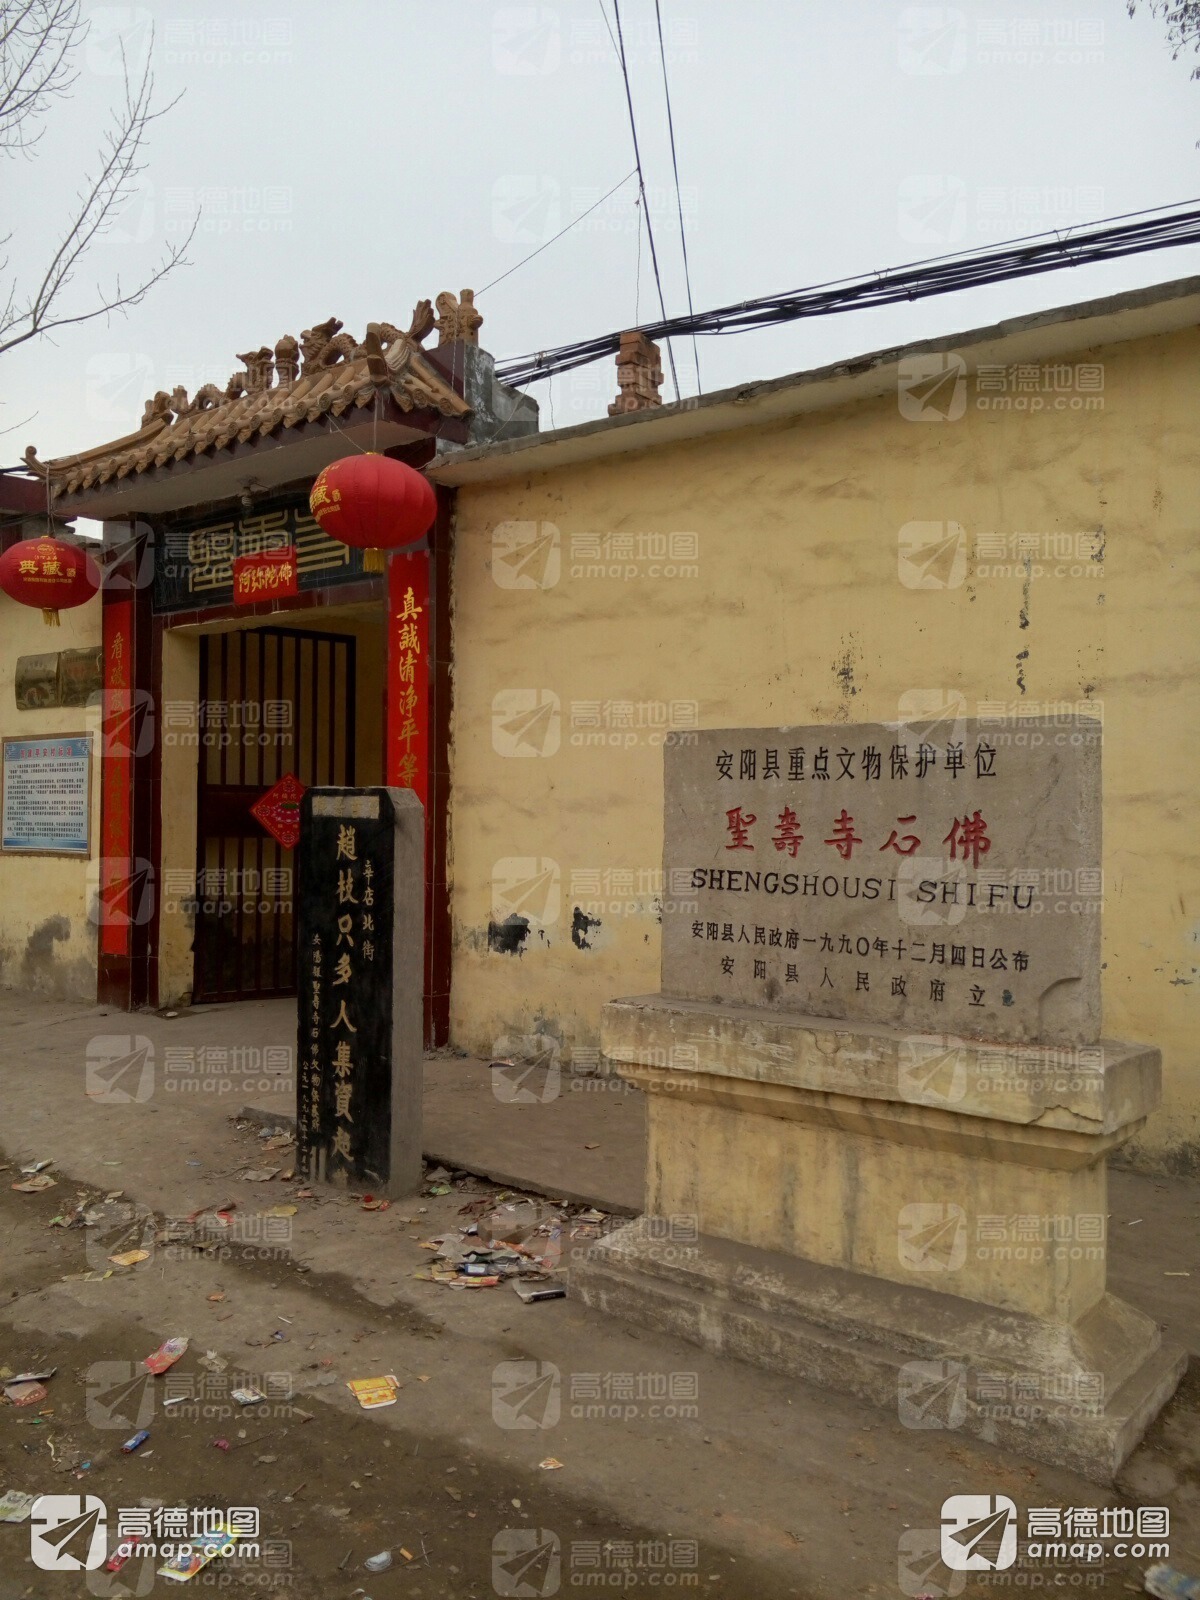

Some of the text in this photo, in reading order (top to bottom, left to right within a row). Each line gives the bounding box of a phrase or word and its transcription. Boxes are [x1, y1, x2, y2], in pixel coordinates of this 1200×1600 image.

[19, 560, 64, 576] 典藏
[239, 561, 293, 593] 阿弥陀佛
[715, 742, 997, 782] 安阳县重点文物保护单位
[725, 806, 993, 870] 聖壽寺石佛
[691, 868, 1036, 910] SHENGSHOUSI SHIFU
[720, 955, 986, 1008] 安阳县人民政府立
